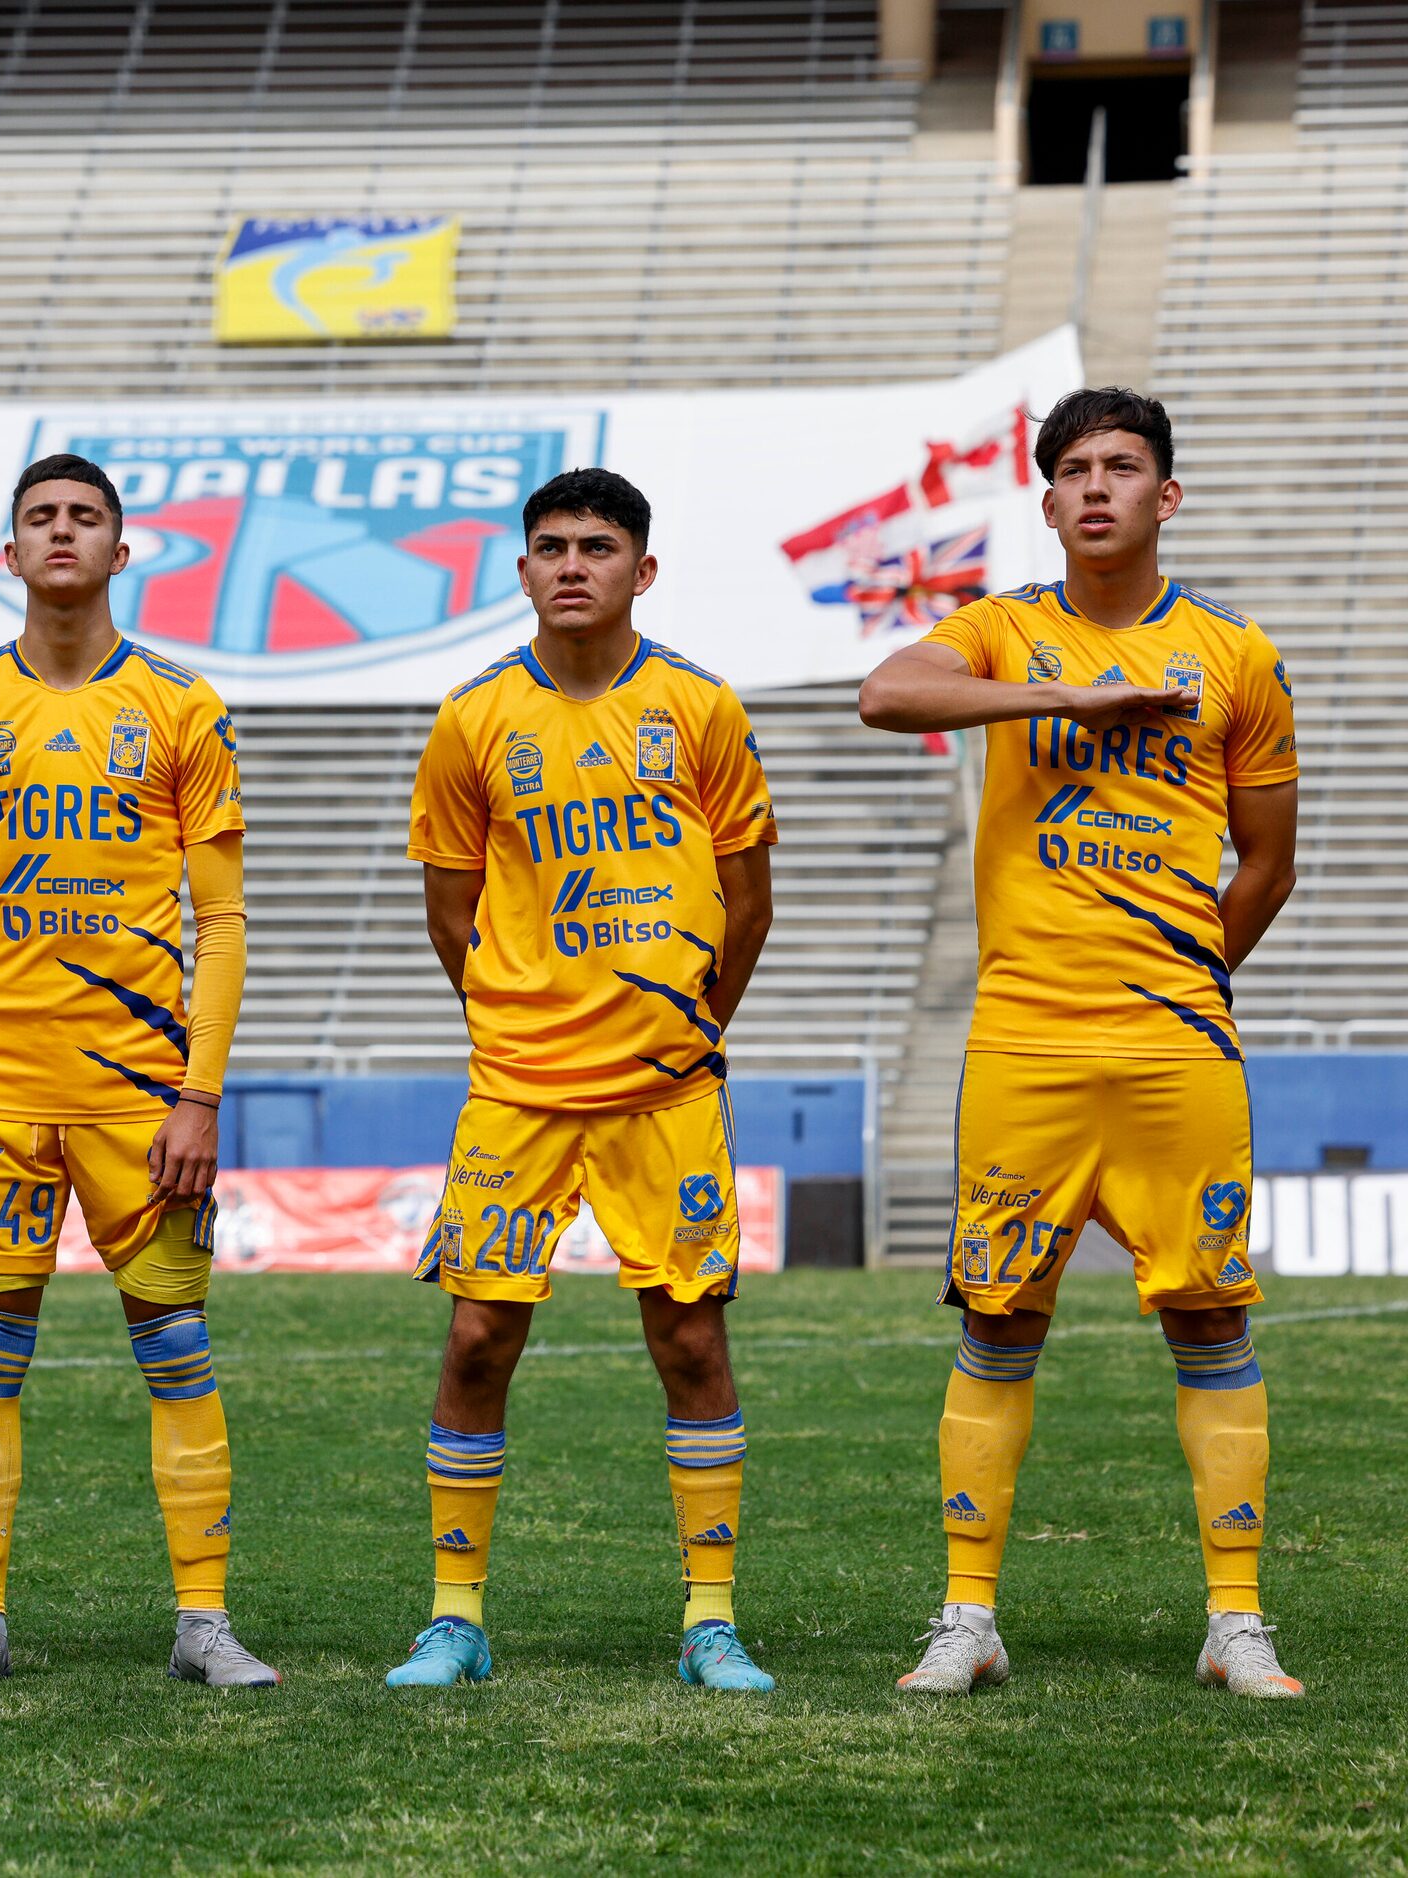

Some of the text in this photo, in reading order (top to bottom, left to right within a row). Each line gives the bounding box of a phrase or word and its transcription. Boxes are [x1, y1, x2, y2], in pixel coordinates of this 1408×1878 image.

[241, 435, 415, 456] WORLD
[427, 434, 524, 453] CUP
[102, 457, 522, 509] DALLAS
[1166, 667, 1201, 681] TIGRES
[113, 725, 147, 737] TIGRES
[639, 728, 673, 738] TIGRES
[44, 743, 80, 752] adidas
[1028, 716, 1192, 786] TIGRES
[506, 753, 542, 770] MONTERREY
[576, 757, 612, 767] adidas
[115, 766, 135, 776] UANL
[644, 770, 666, 778] UANL
[515, 782, 540, 793] EXTRA
[515, 794, 682, 863] TIGRES
[1077, 809, 1172, 836] CEMEX
[1077, 841, 1162, 874] Bitso
[36, 877, 125, 896] CEMEX
[587, 884, 673, 909] CEMEX
[39, 907, 119, 935] Bitso
[593, 917, 671, 948] Bitso
[452, 1164, 505, 1189] Vertua
[971, 1183, 1031, 1208] Vertua
[475, 1204, 555, 1275] 202
[676, 1224, 729, 1240] OXXO GAS
[964, 1240, 988, 1248] TIGRES
[1200, 1236, 1224, 1248] OXXO
[697, 1264, 733, 1276] adidas
[675, 1494, 689, 1547] aerobus
[1212, 1518, 1263, 1529] adidas
[432, 1540, 477, 1552] adidas
[689, 1536, 737, 1546] adidas
